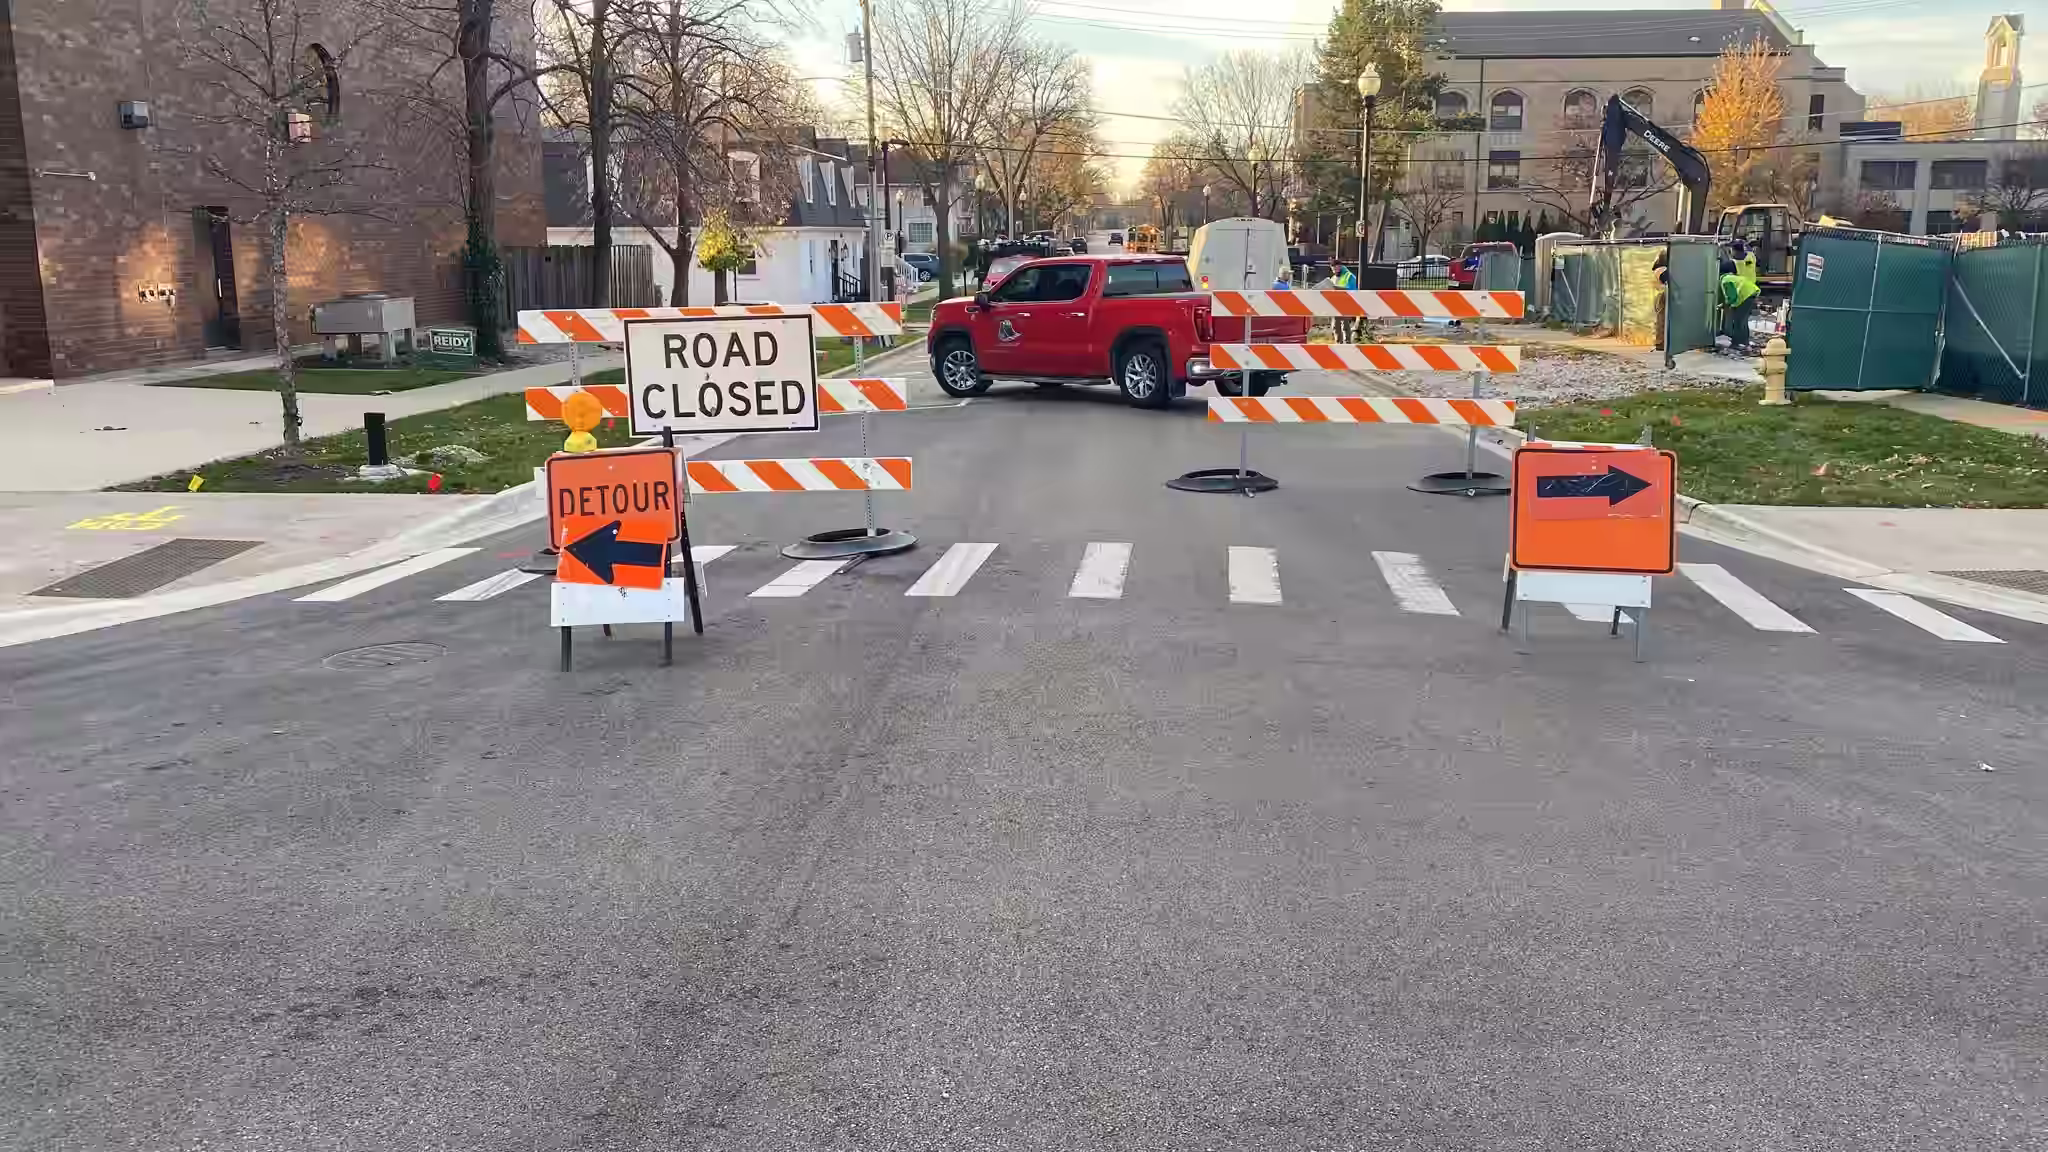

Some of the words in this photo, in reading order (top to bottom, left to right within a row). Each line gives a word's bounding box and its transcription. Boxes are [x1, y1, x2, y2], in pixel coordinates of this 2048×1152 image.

[1643, 129, 1671, 152] DEERE
[433, 335, 469, 348] REIDY
[663, 331, 778, 369] ROAD
[642, 380, 806, 419] CLOSED
[559, 481, 671, 518] DETOUR
